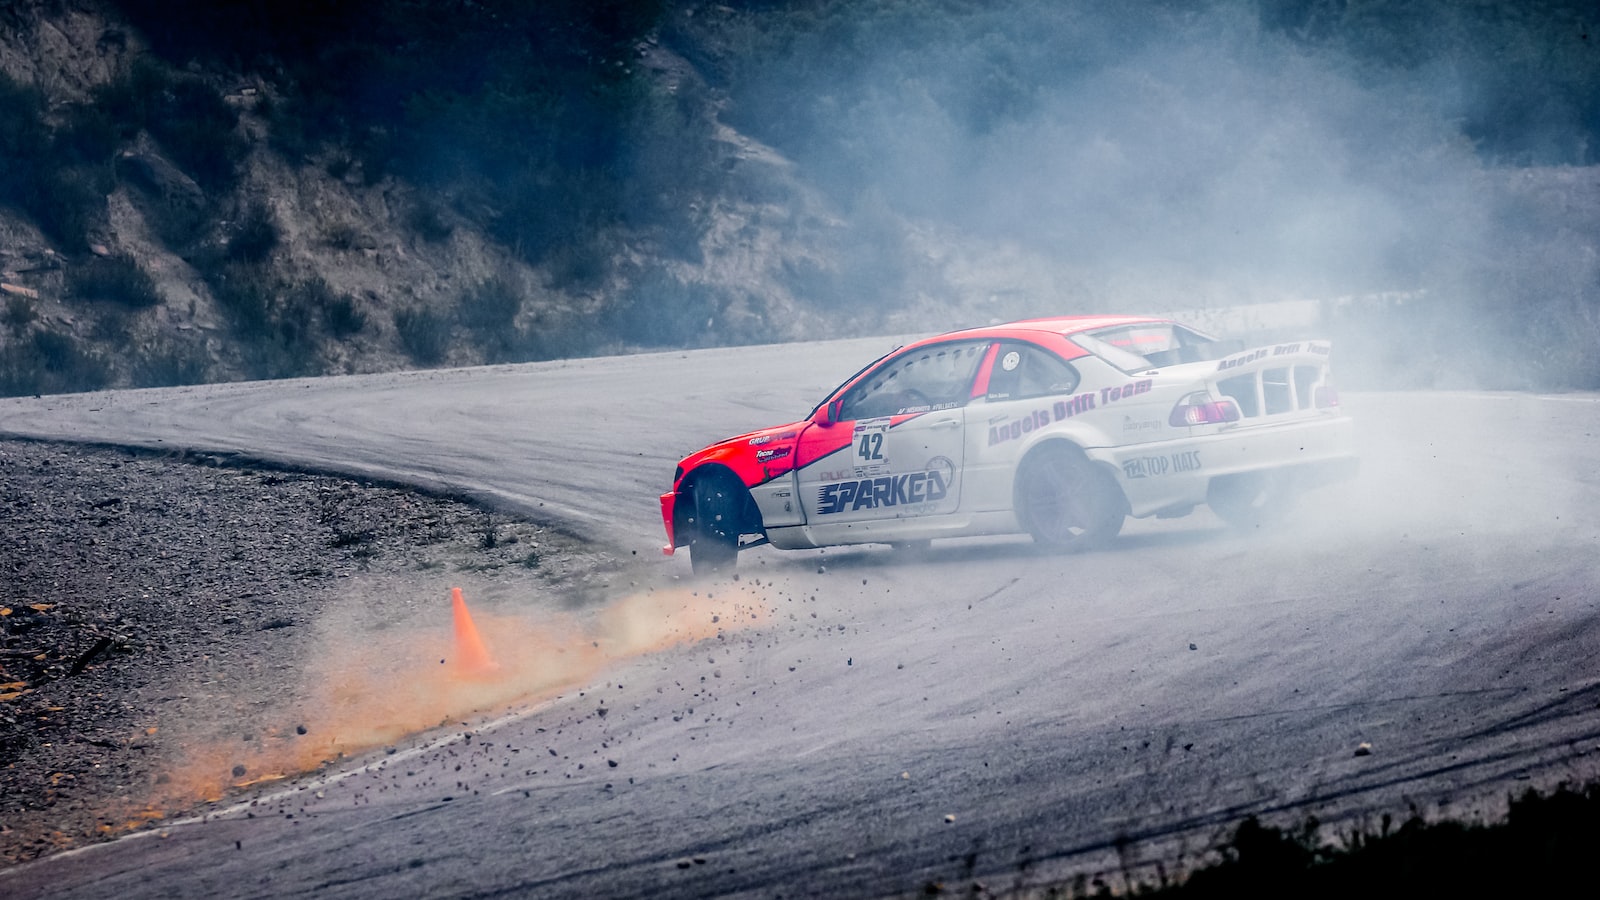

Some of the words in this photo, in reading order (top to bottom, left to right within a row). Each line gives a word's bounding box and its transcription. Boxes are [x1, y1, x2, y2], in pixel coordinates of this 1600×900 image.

[988, 409, 1050, 447] Angels
[1053, 393, 1096, 422] Drift
[1100, 379, 1153, 405] Team
[858, 432, 883, 461] 42
[1142, 455, 1169, 476] TOP
[1173, 450, 1201, 473] HATS
[816, 470, 947, 514] SPARKED
